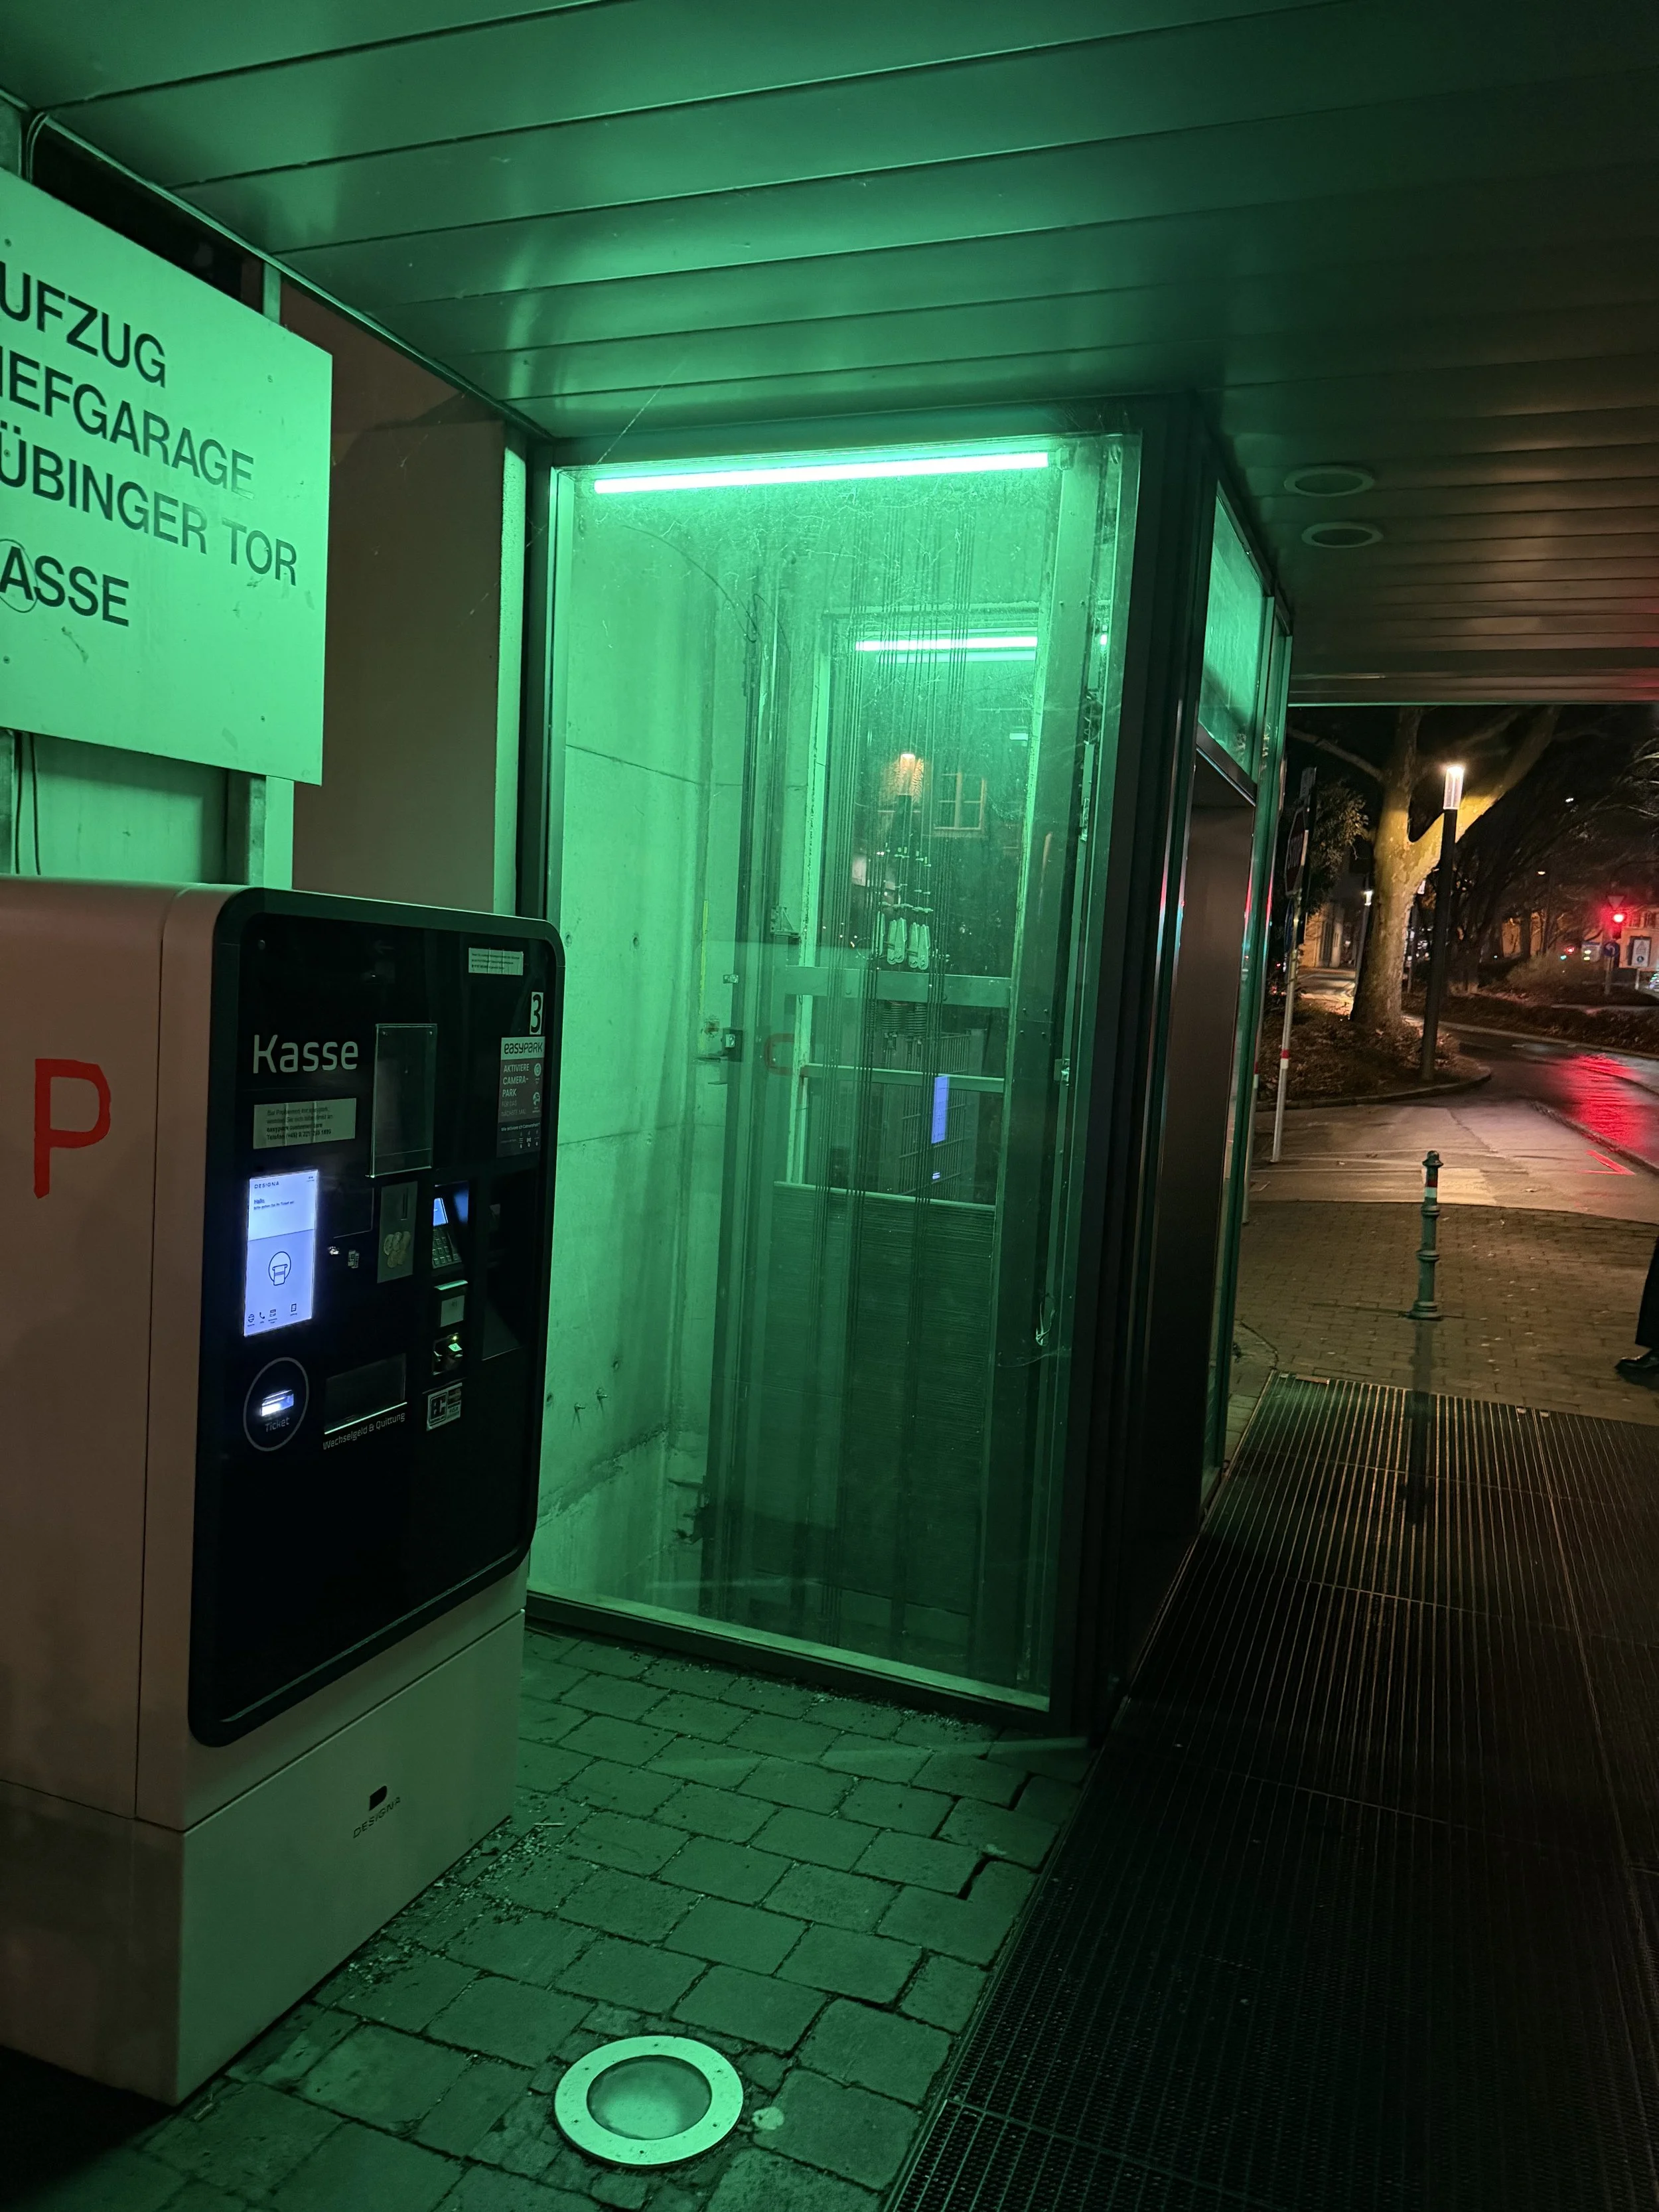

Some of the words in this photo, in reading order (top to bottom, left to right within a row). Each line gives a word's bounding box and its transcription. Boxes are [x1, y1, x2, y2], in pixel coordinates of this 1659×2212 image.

[222, 517, 297, 586] TOR
[531, 994, 541, 1033] 3
[253, 1034, 359, 1074] Kasse
[504, 1063, 530, 1073] AKTIVIERE
[502, 1076, 530, 1085] CAMERA-
[502, 1088, 517, 1097] PARK
[32, 1057, 112, 1199] P
[265, 1417, 290, 1432] Ticket
[323, 1426, 368, 1449] Wechselgeld
[369, 1422, 376, 1432] &
[353, 1797, 401, 1838] DESIGNA
